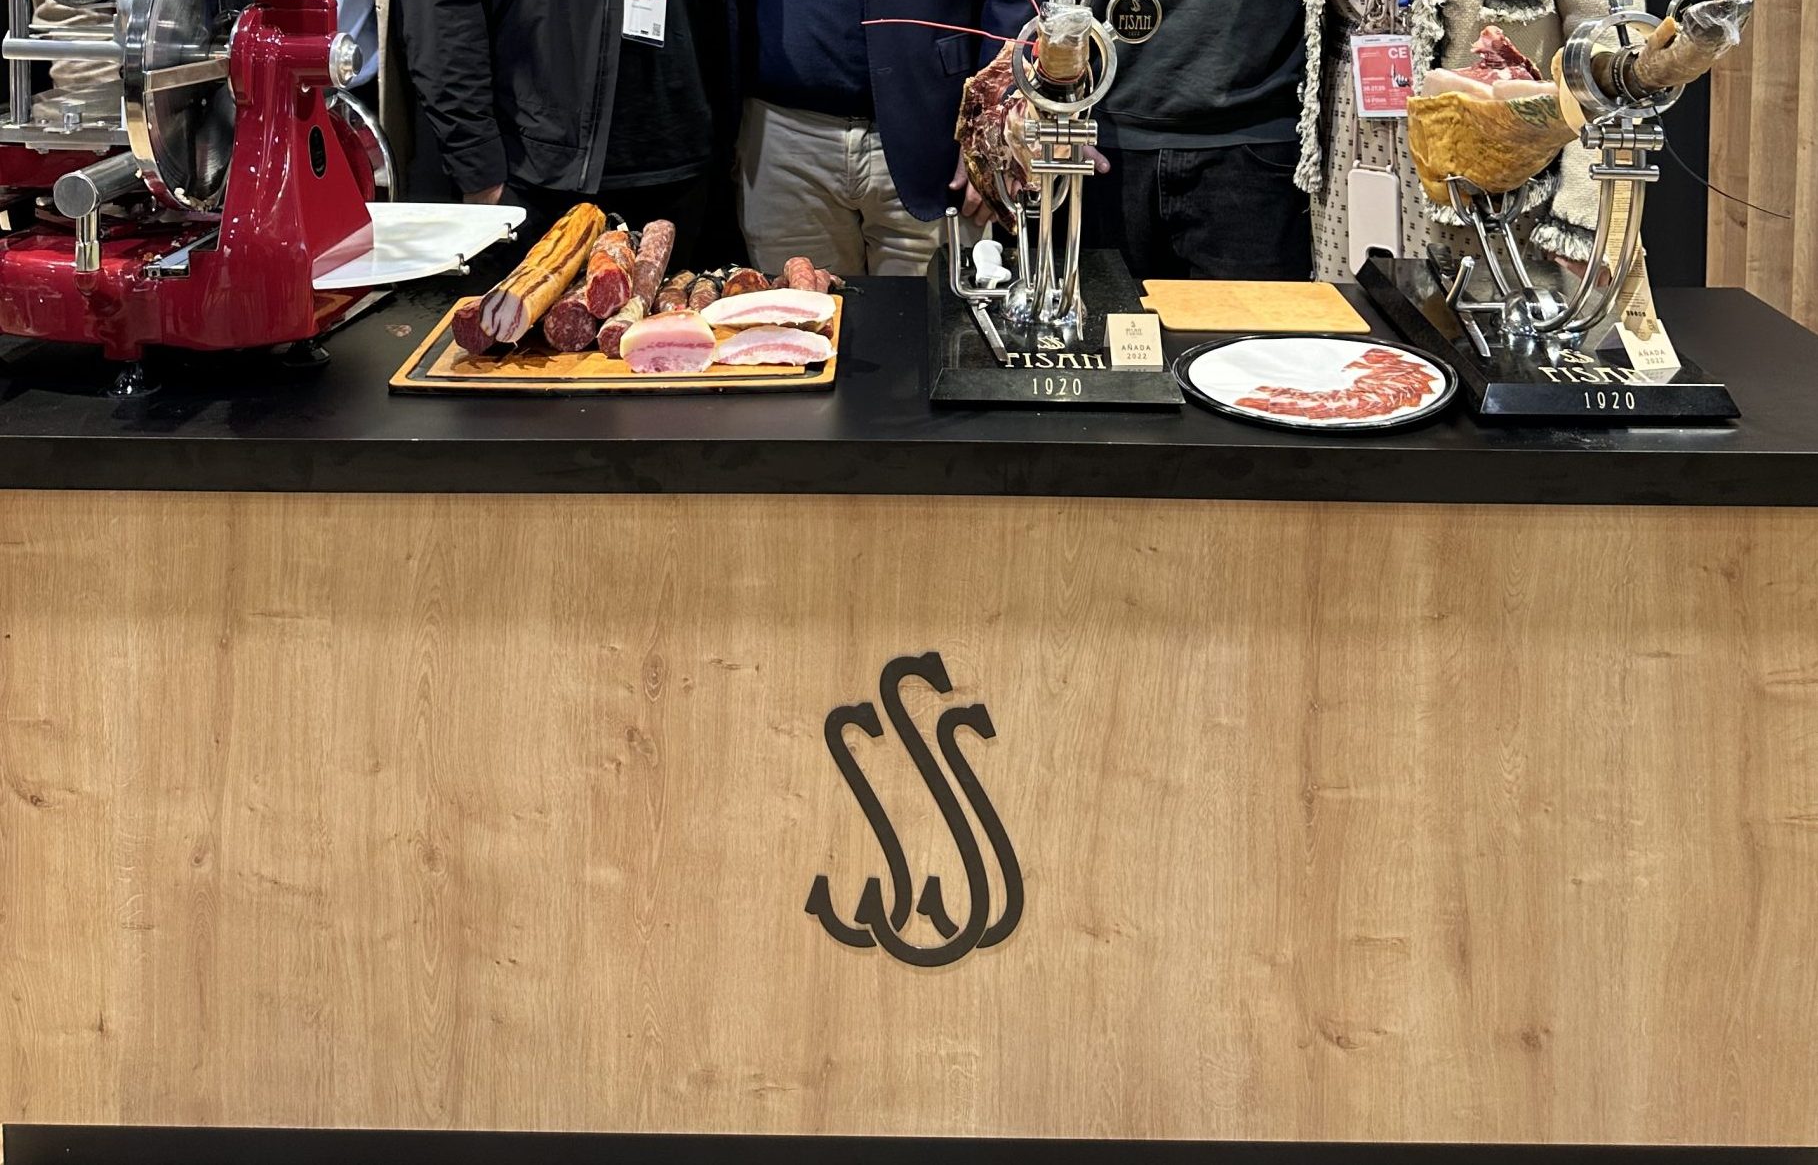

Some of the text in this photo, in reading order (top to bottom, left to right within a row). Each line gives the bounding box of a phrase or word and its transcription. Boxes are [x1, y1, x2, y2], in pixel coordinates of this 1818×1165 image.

[1118, 14, 1152, 30] FISAN
[1388, 46, 1408, 59] CE
[1121, 343, 1151, 351] AÑADA
[1538, 366, 1655, 383] FISAN
[1032, 377, 1082, 396] 1920
[1584, 391, 1635, 410] 1920
